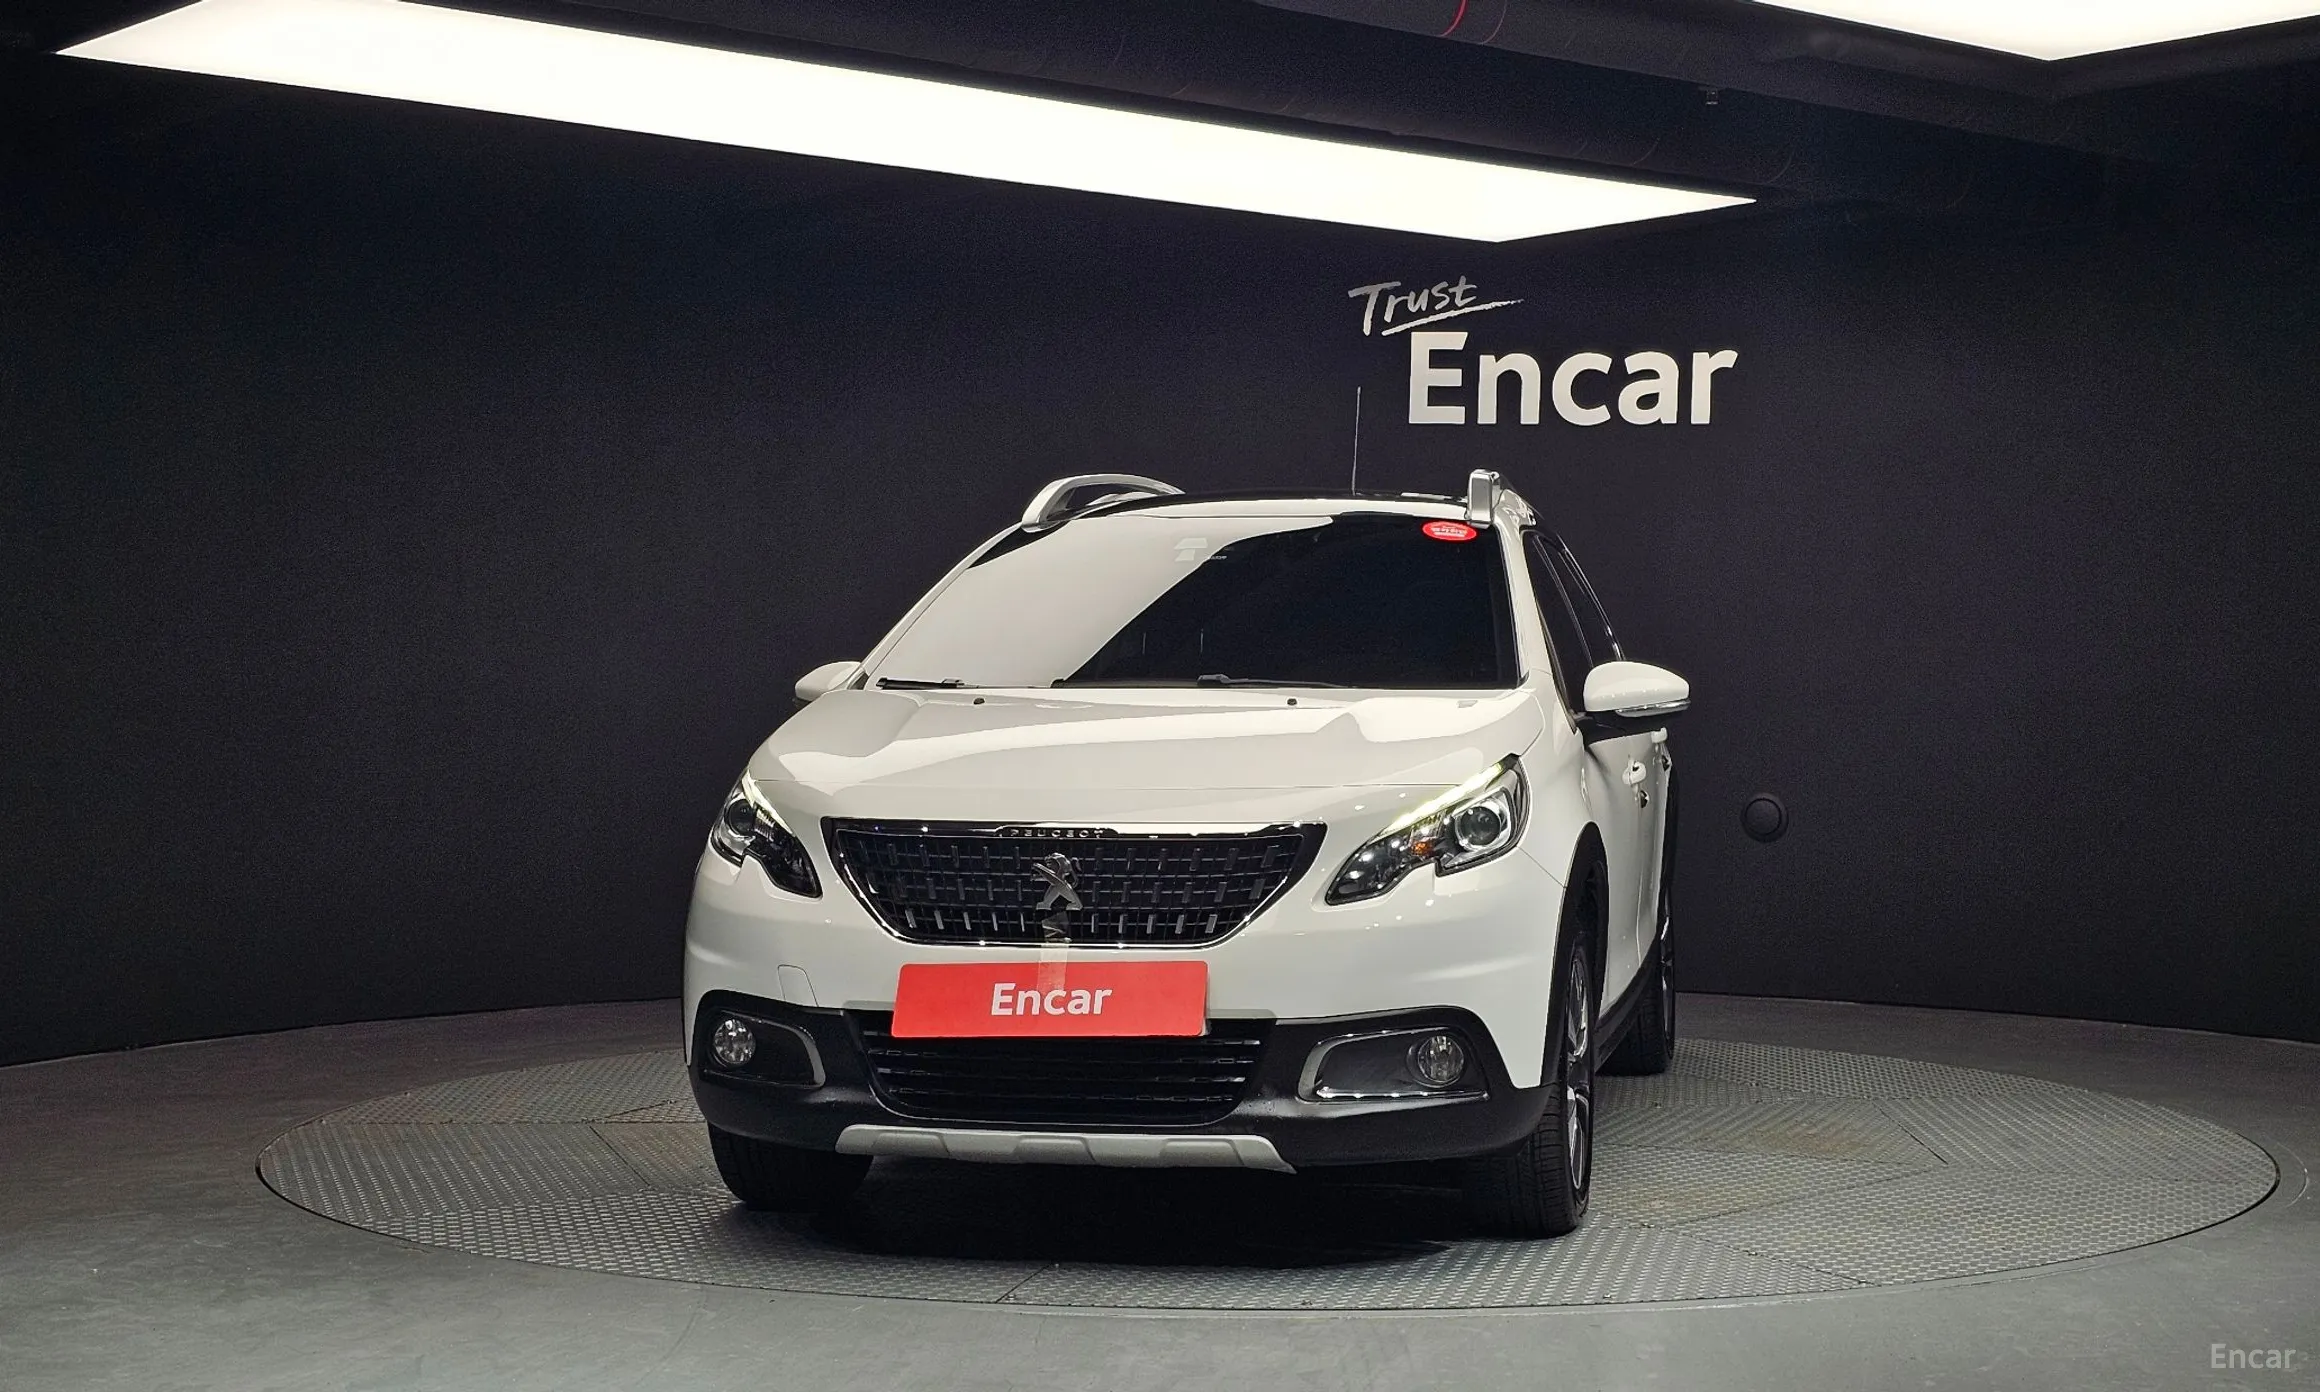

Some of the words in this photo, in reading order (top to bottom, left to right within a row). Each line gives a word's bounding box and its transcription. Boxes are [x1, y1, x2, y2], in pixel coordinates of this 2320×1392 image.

[1347, 275, 1478, 337] Trust
[1408, 331, 1739, 426] Encar
[991, 982, 1113, 1016] Encar
